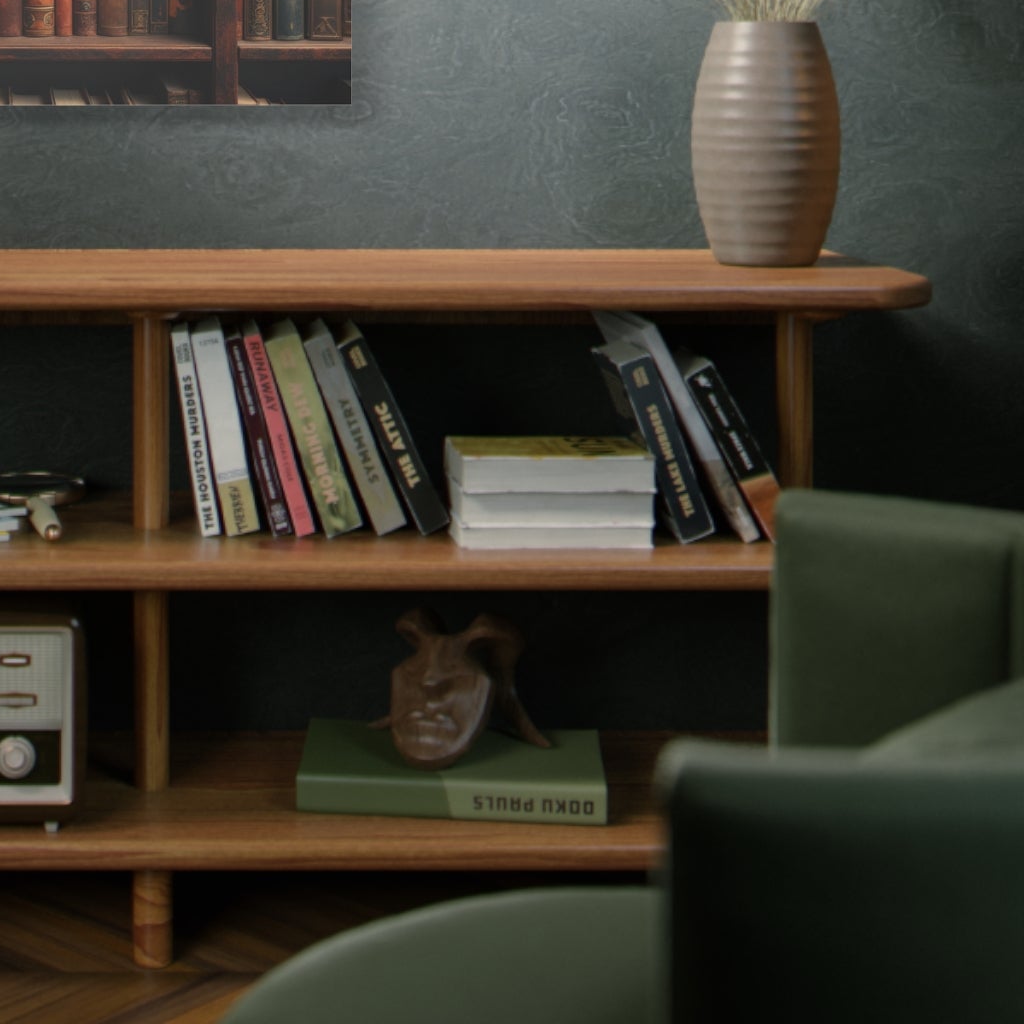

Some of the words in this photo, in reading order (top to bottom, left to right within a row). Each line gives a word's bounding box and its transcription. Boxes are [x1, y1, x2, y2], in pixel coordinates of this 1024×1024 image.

[250, 342, 278, 413] RUNAWAY
[182, 375, 201, 435] MURDERS
[287, 382, 314, 420] DEW
[340, 398, 379, 484] SYMMETRY
[373, 401, 406, 451] ATTIC
[645, 403, 675, 462] MURDERS
[193, 439, 210, 501] HOUSTON
[303, 421, 339, 505] MORNING
[397, 453, 422, 489] THE
[666, 460, 686, 494] LAKE
[203, 505, 214, 530] THE
[678, 493, 696, 519] THE
[472, 796, 535, 813] PAULS
[541, 799, 595, 816] DOKU
